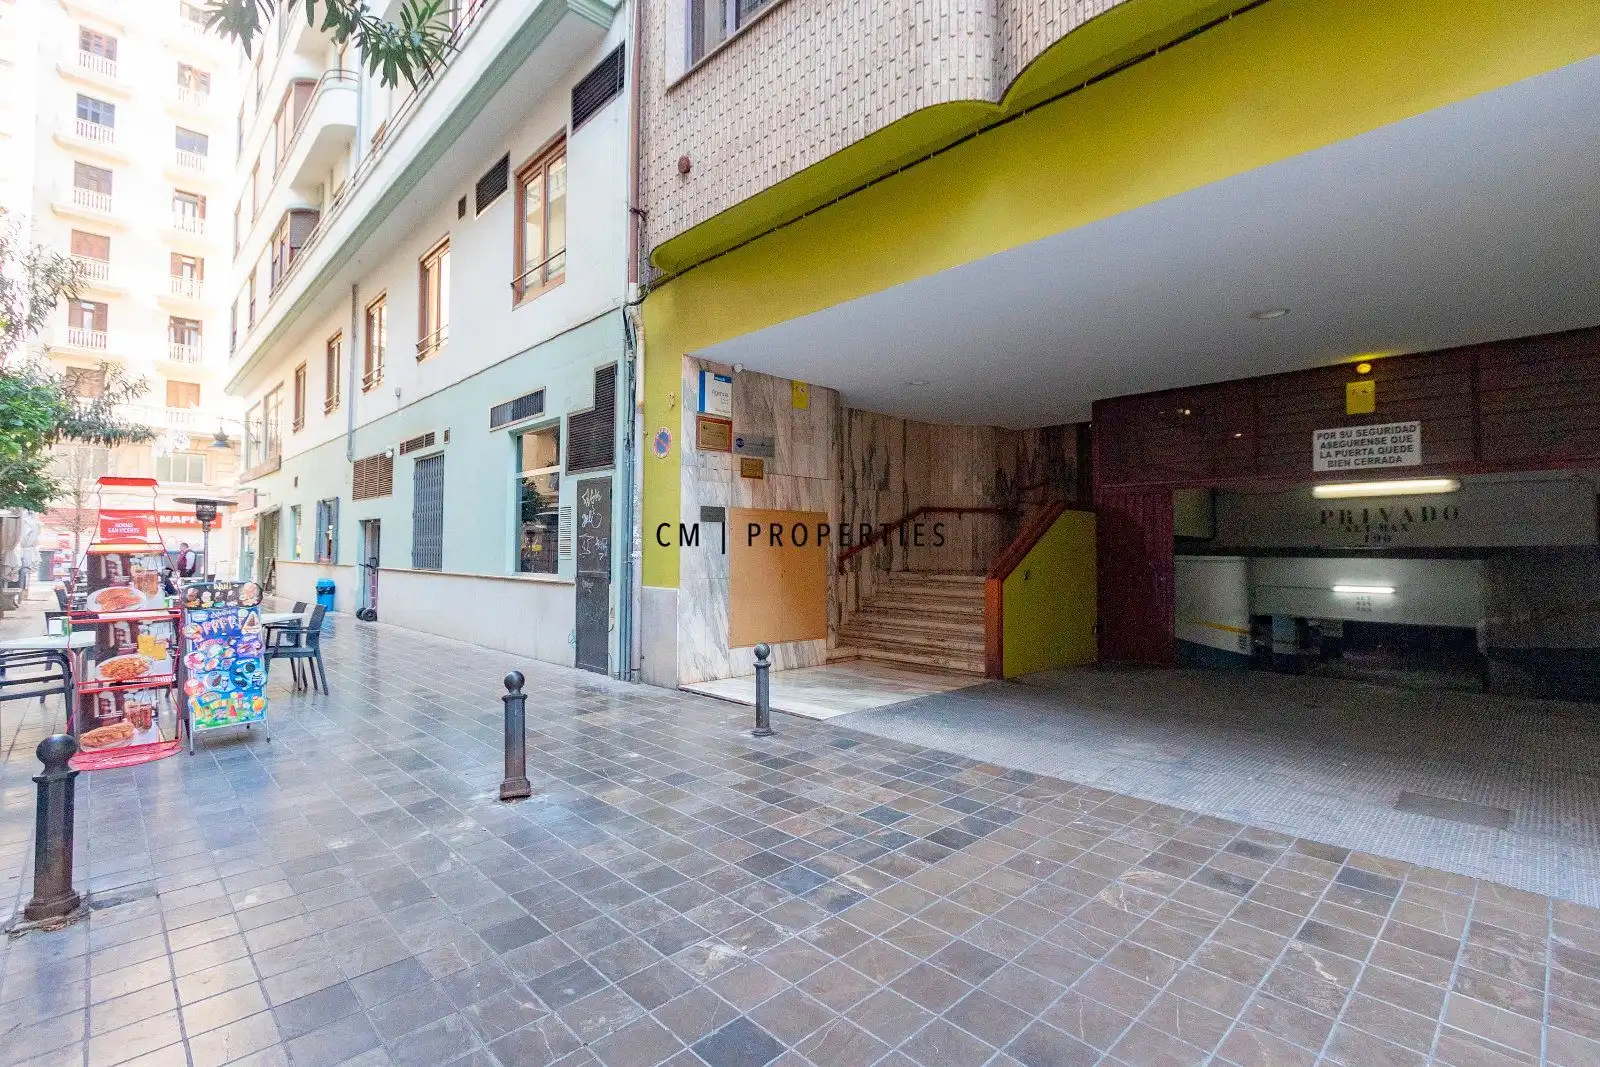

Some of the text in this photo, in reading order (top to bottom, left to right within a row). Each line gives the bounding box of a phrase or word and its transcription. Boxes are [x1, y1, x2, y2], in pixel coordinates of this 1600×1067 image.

[1317, 424, 1417, 440] POR SU SEGURIDAD
[1320, 435, 1413, 449] ASEGURENSE QUE
[1320, 444, 1414, 459] LA PUERTA QUEDE
[1327, 455, 1402, 468] BIEN CERRADA
[1319, 505, 1460, 526] PRIVADO
